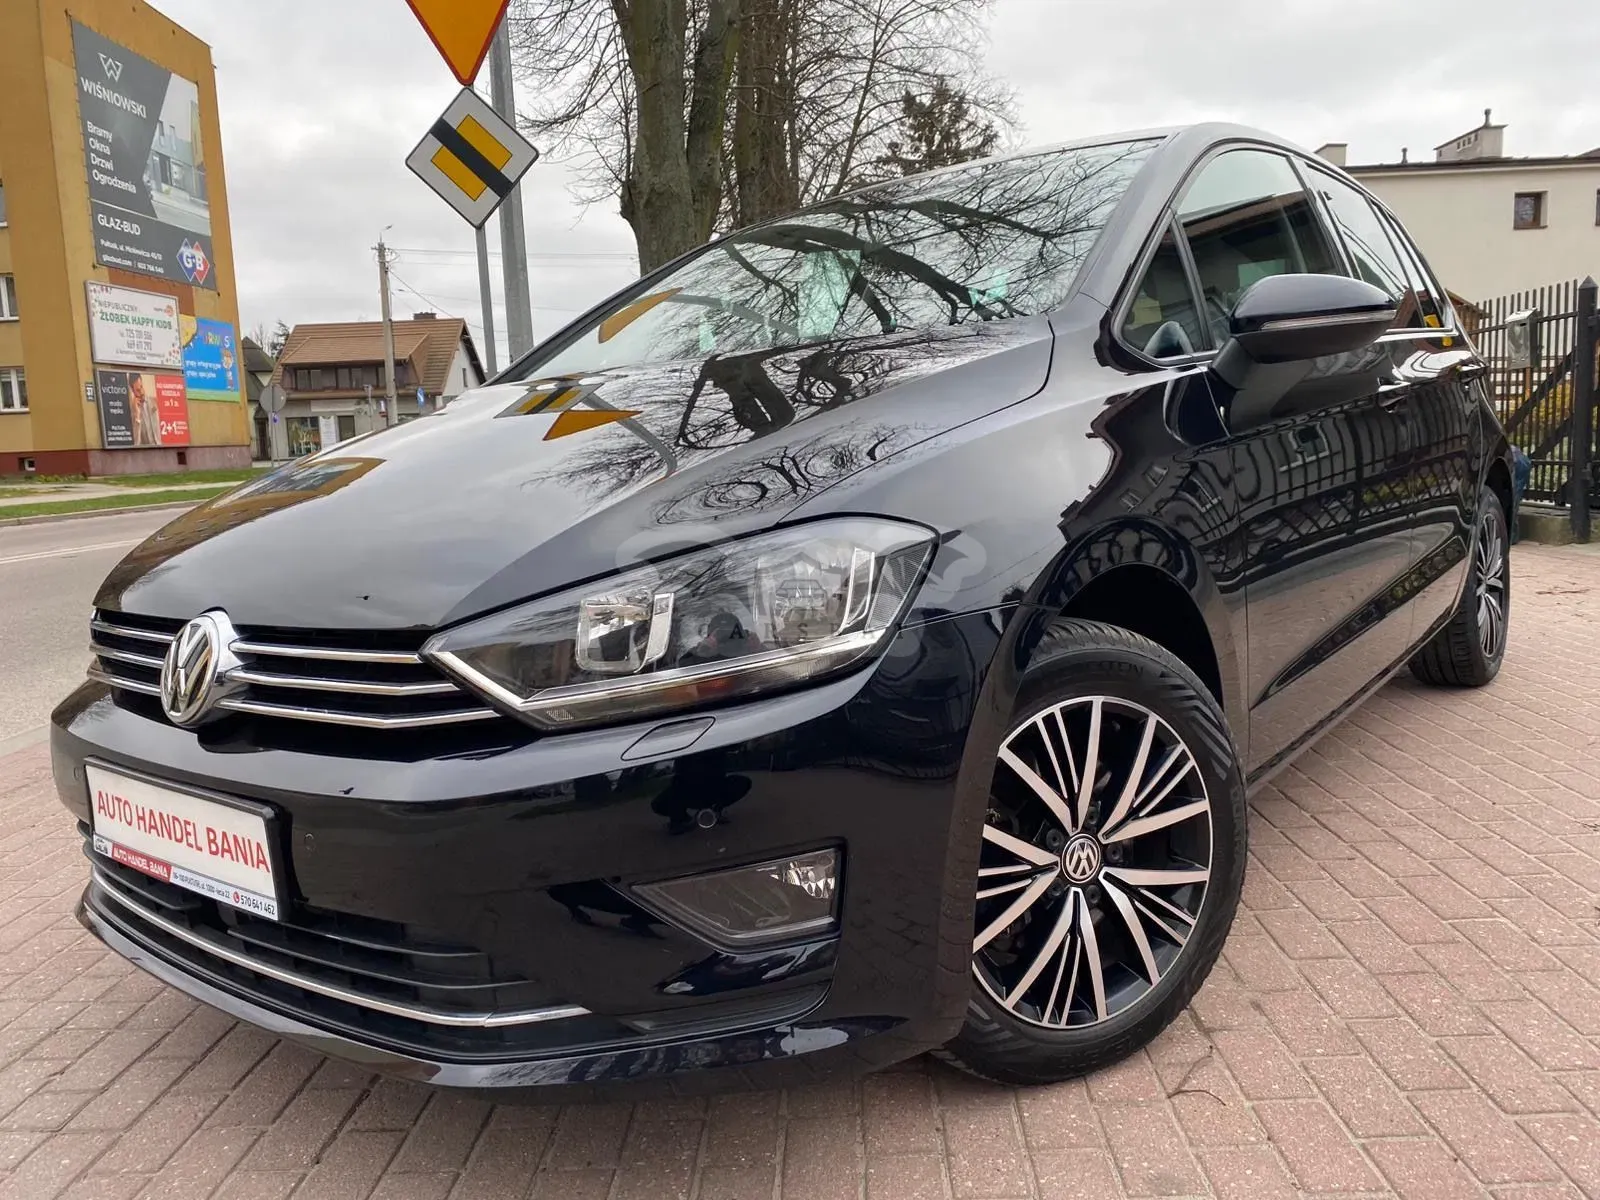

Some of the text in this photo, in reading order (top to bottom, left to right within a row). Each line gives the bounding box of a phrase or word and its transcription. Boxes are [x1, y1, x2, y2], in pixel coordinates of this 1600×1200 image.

[81, 77, 147, 119] WIŚNIOWSKI
[87, 120, 112, 142] Bramy
[88, 137, 111, 155] Okna
[90, 152, 114, 171] Drzwi
[92, 169, 137, 194] Ogrodzenia
[97, 213, 141, 235] GLAZ-BUD
[131, 316, 154, 328] HAPPY
[156, 319, 172, 330] KIDS
[97, 790, 271, 873] AUTO HANDEL BANIA
[114, 846, 168, 878] AUTO HANDEL BANIA
[240, 895, 276, 916] 570 641 462
